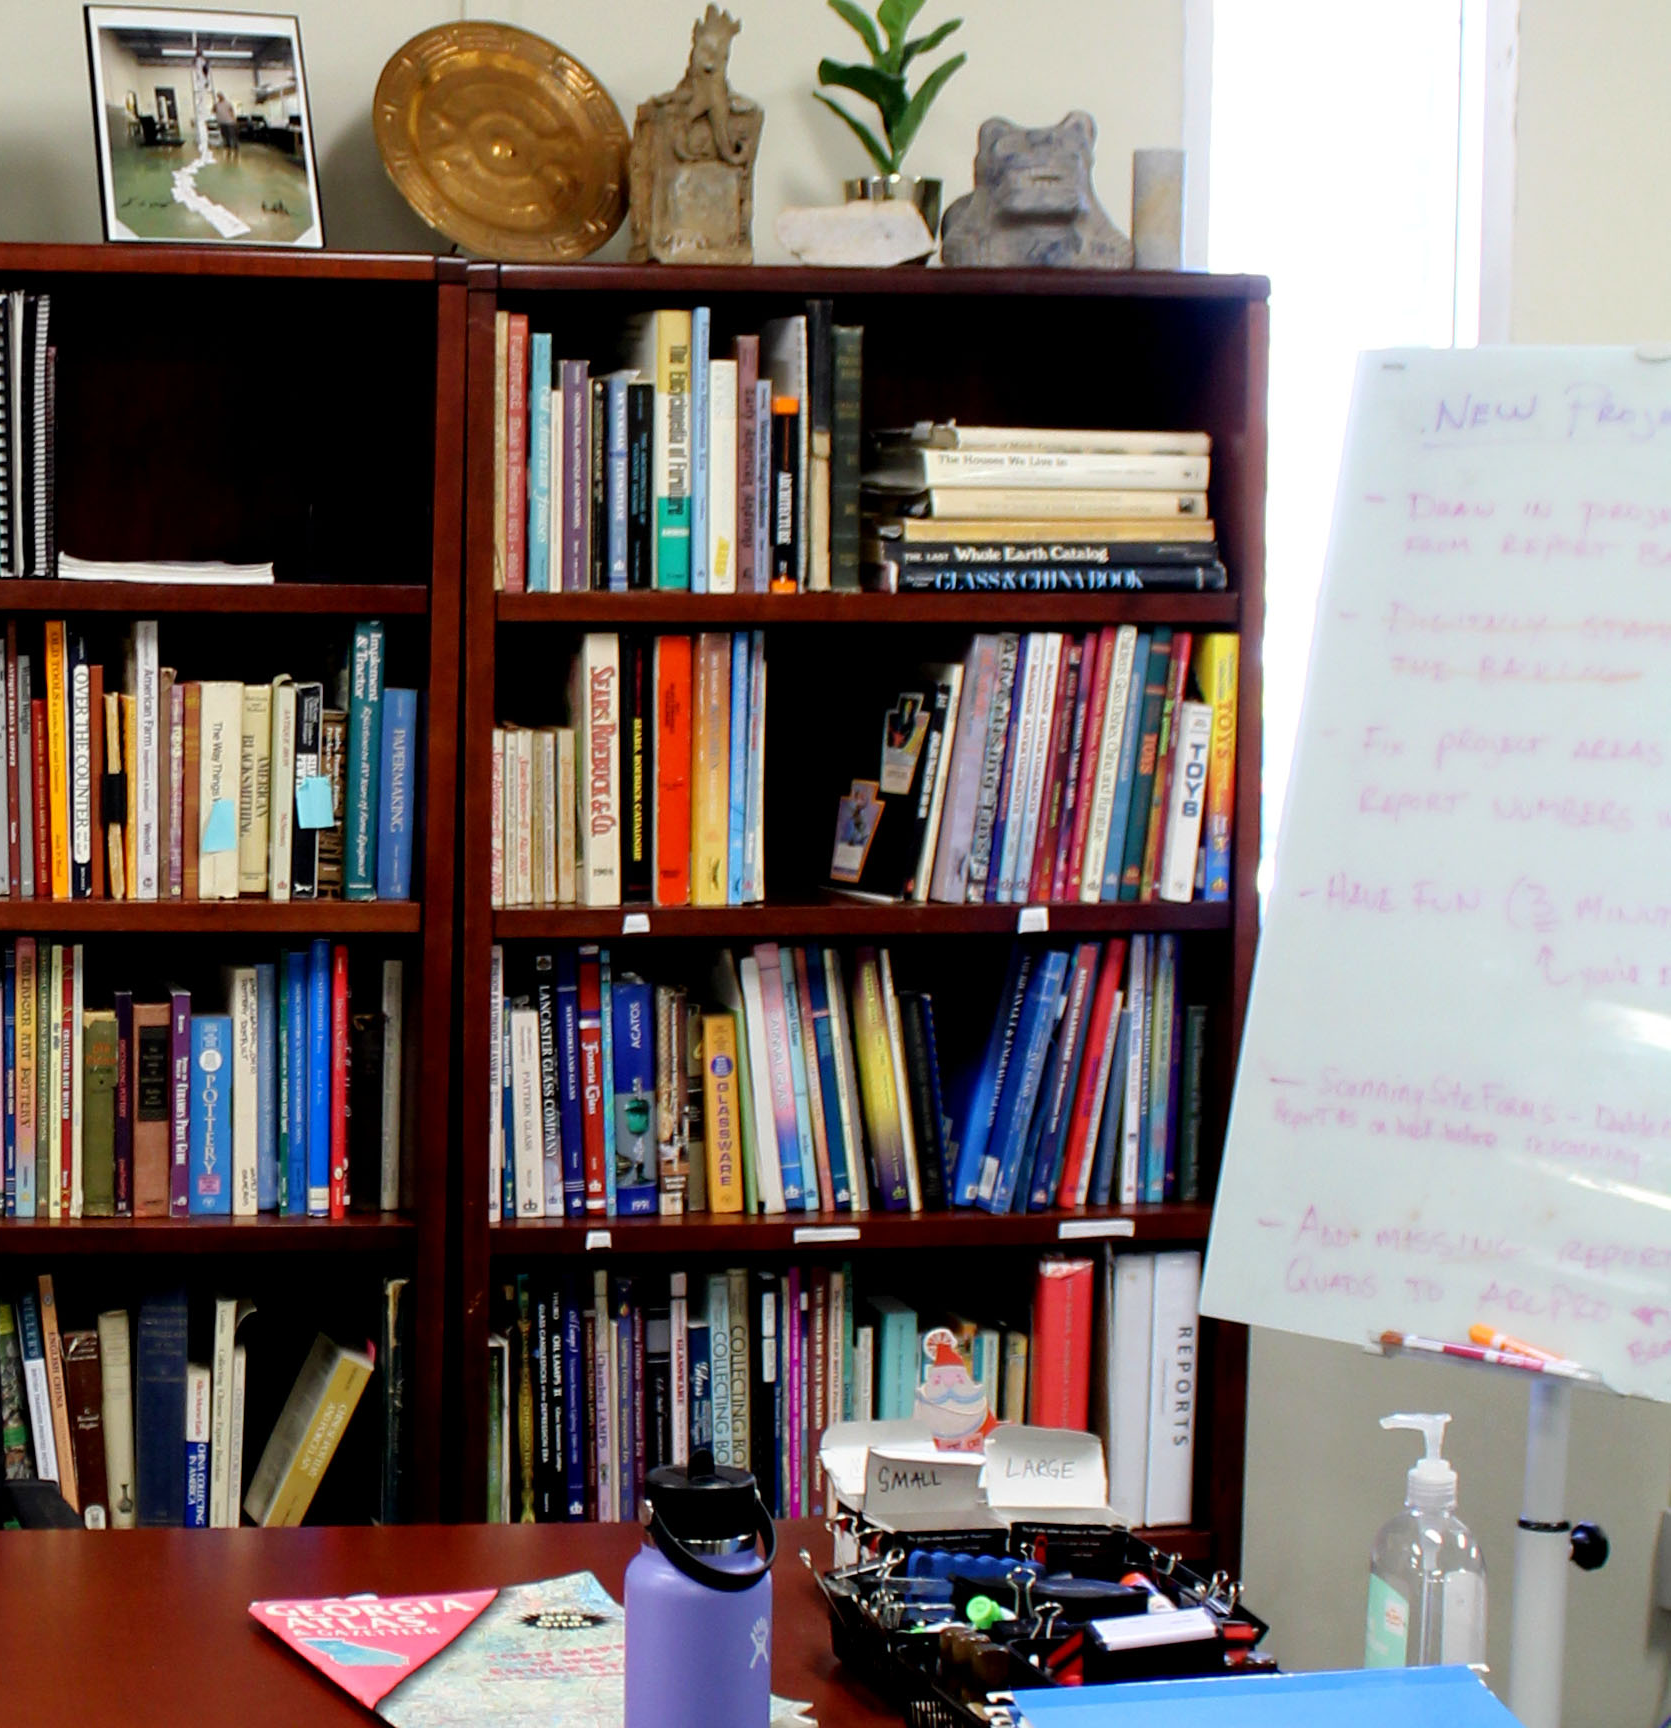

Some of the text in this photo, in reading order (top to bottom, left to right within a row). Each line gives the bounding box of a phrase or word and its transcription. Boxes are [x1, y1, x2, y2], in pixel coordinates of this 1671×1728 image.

[666, 371, 688, 517] Encyclopedia Furniture
[1434, 392, 1538, 434] NEW
[938, 454, 1053, 467] The Houses We Live
[954, 547, 1110, 564] Whole Earth Catalog
[50, 631, 61, 701] OLD TOOLS
[354, 650, 368, 701] Tractor
[368, 632, 382, 704] Implement
[144, 668, 154, 747] American Farm
[982, 638, 1017, 791] Advertising
[1217, 699, 1233, 760] TOYS
[74, 673, 89, 829] OVER THE COUNTER
[210, 721, 222, 797] The Way Things
[240, 733, 254, 838] BLACKSMITHING
[257, 752, 269, 819] AMERICAN
[390, 727, 406, 833] PAPERMAKING
[1411, 878, 1481, 914] FUN
[566, 1005, 575, 1072] WESTMORELAND
[631, 1000, 641, 1049] ACATOS
[21, 1031, 32, 1129] ART POTTERY
[539, 984, 556, 1159] LANCASTER GLASS COMPANY
[582, 1040, 600, 1116] Fostoria Glass
[203, 1074, 217, 1176] POTTERY
[716, 1081, 732, 1188] GLASSWARE
[1375, 1224, 1518, 1259] MISSING
[1284, 1255, 1445, 1304] QUADS TO
[48, 1330, 62, 1409] ENGLISH CHINA
[553, 1335, 561, 1386] OIL LAMPS
[714, 1330, 729, 1435] COLLECTING
[730, 1324, 746, 1433] COLLECTING
[1173, 1325, 1192, 1448] REPORTS
[597, 1354, 607, 1449] Chamber LAMPS
[188, 1467, 197, 1506] AMERICA
[195, 1444, 206, 1525] CHINA COLLECTING
[877, 1466, 942, 1493] SMALL
[1005, 1458, 1076, 1480] LARGE
[265, 1599, 475, 1618] GEORGIA
[286, 1615, 429, 1631] ATLAS
[306, 1626, 441, 1638] GAZETTEER
